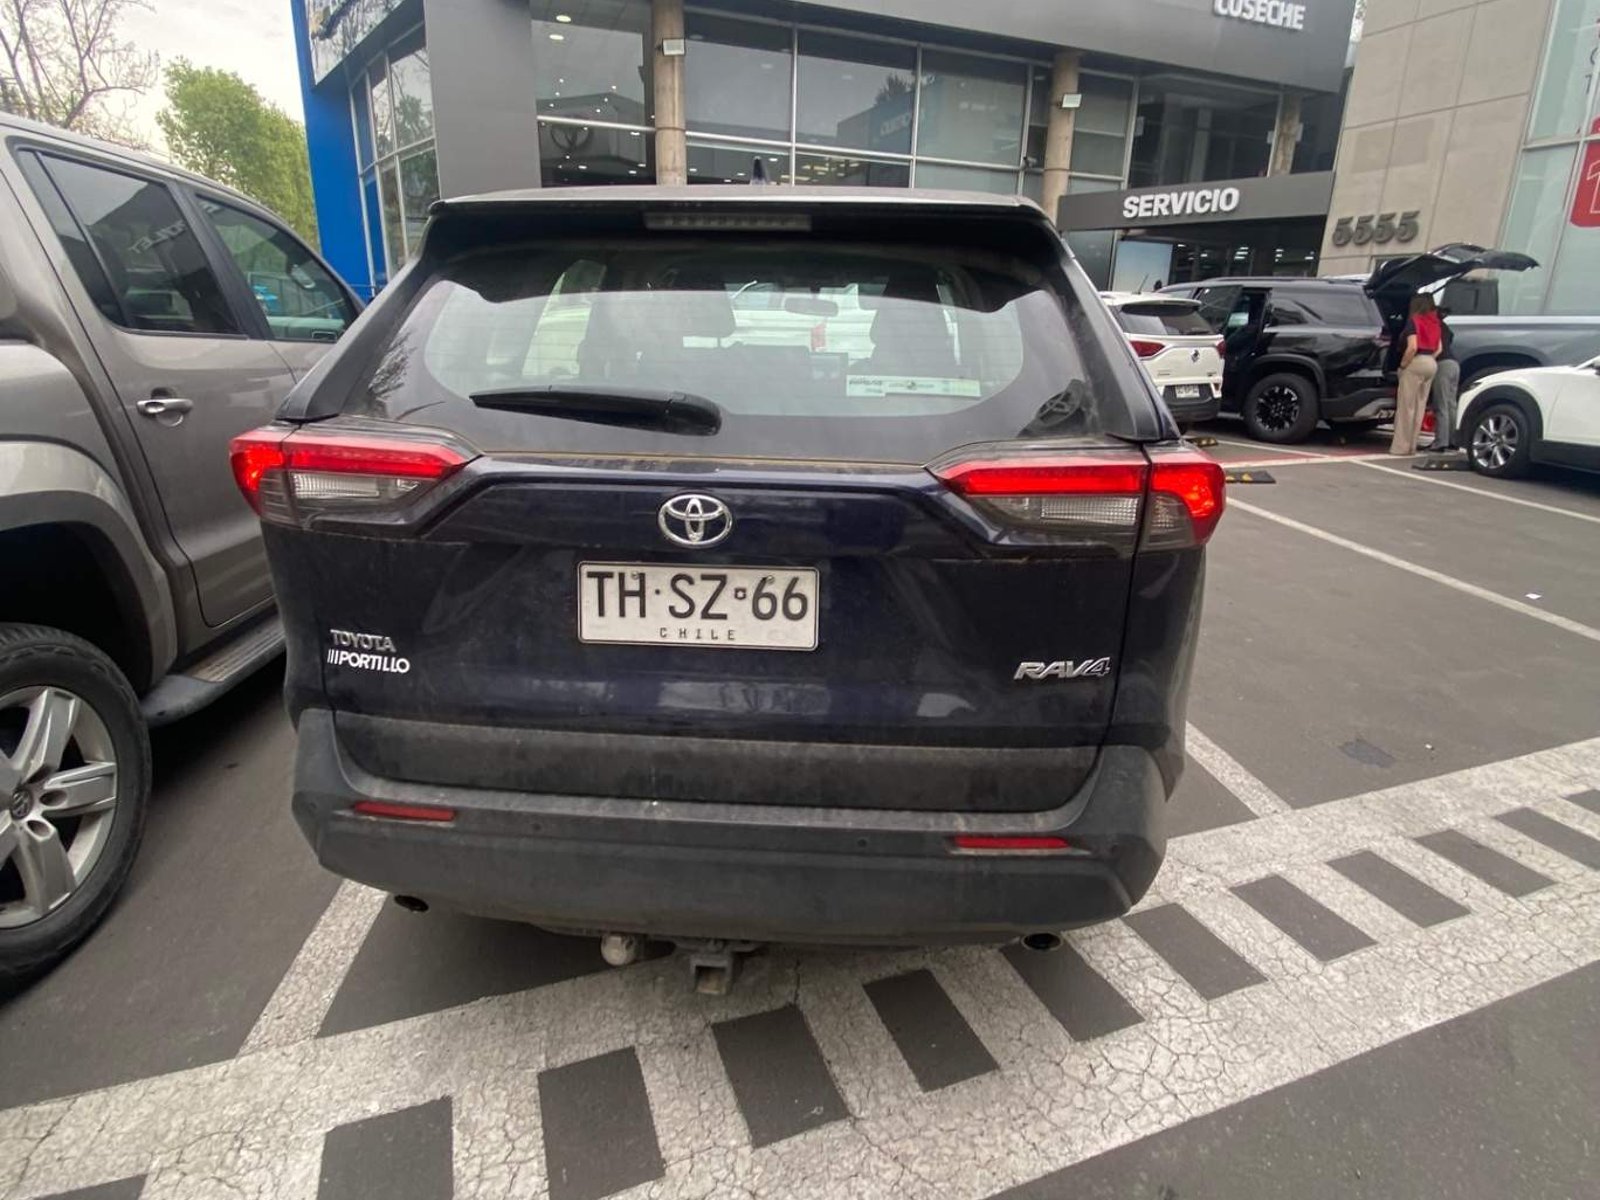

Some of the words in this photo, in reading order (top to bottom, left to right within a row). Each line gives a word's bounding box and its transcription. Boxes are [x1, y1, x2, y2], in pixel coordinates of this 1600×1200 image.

[1214, 0, 1306, 30] COSECHE
[1122, 187, 1240, 218] SERVICIO
[1332, 210, 1420, 247] 5555
[330, 628, 397, 653] TOYOTA
[659, 627, 736, 641] CHILE
[1013, 656, 1111, 680] RAV4
